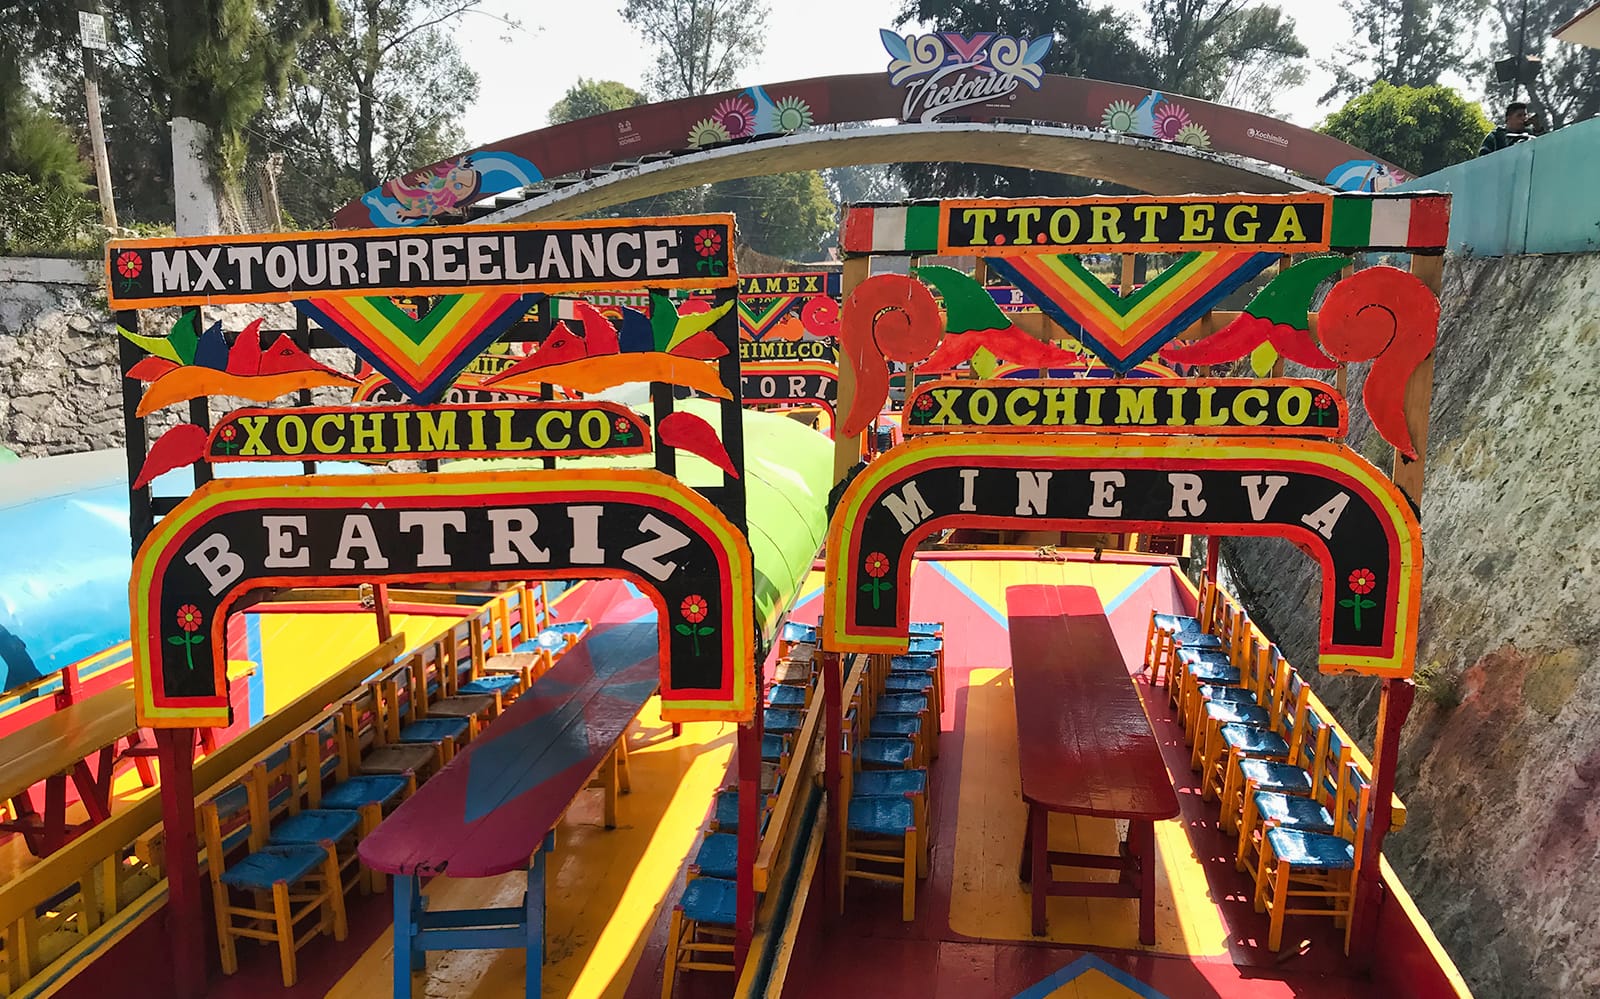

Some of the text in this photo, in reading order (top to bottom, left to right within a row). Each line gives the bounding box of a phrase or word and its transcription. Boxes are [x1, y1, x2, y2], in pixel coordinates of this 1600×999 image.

[902, 50, 1018, 123] Victoria
[238, 410, 612, 456] XOCHIMILCO
[931, 386, 1314, 426] XOCHIMILCO
[881, 469, 1350, 540] MINERVA
[185, 505, 691, 596] BEATRIZ
